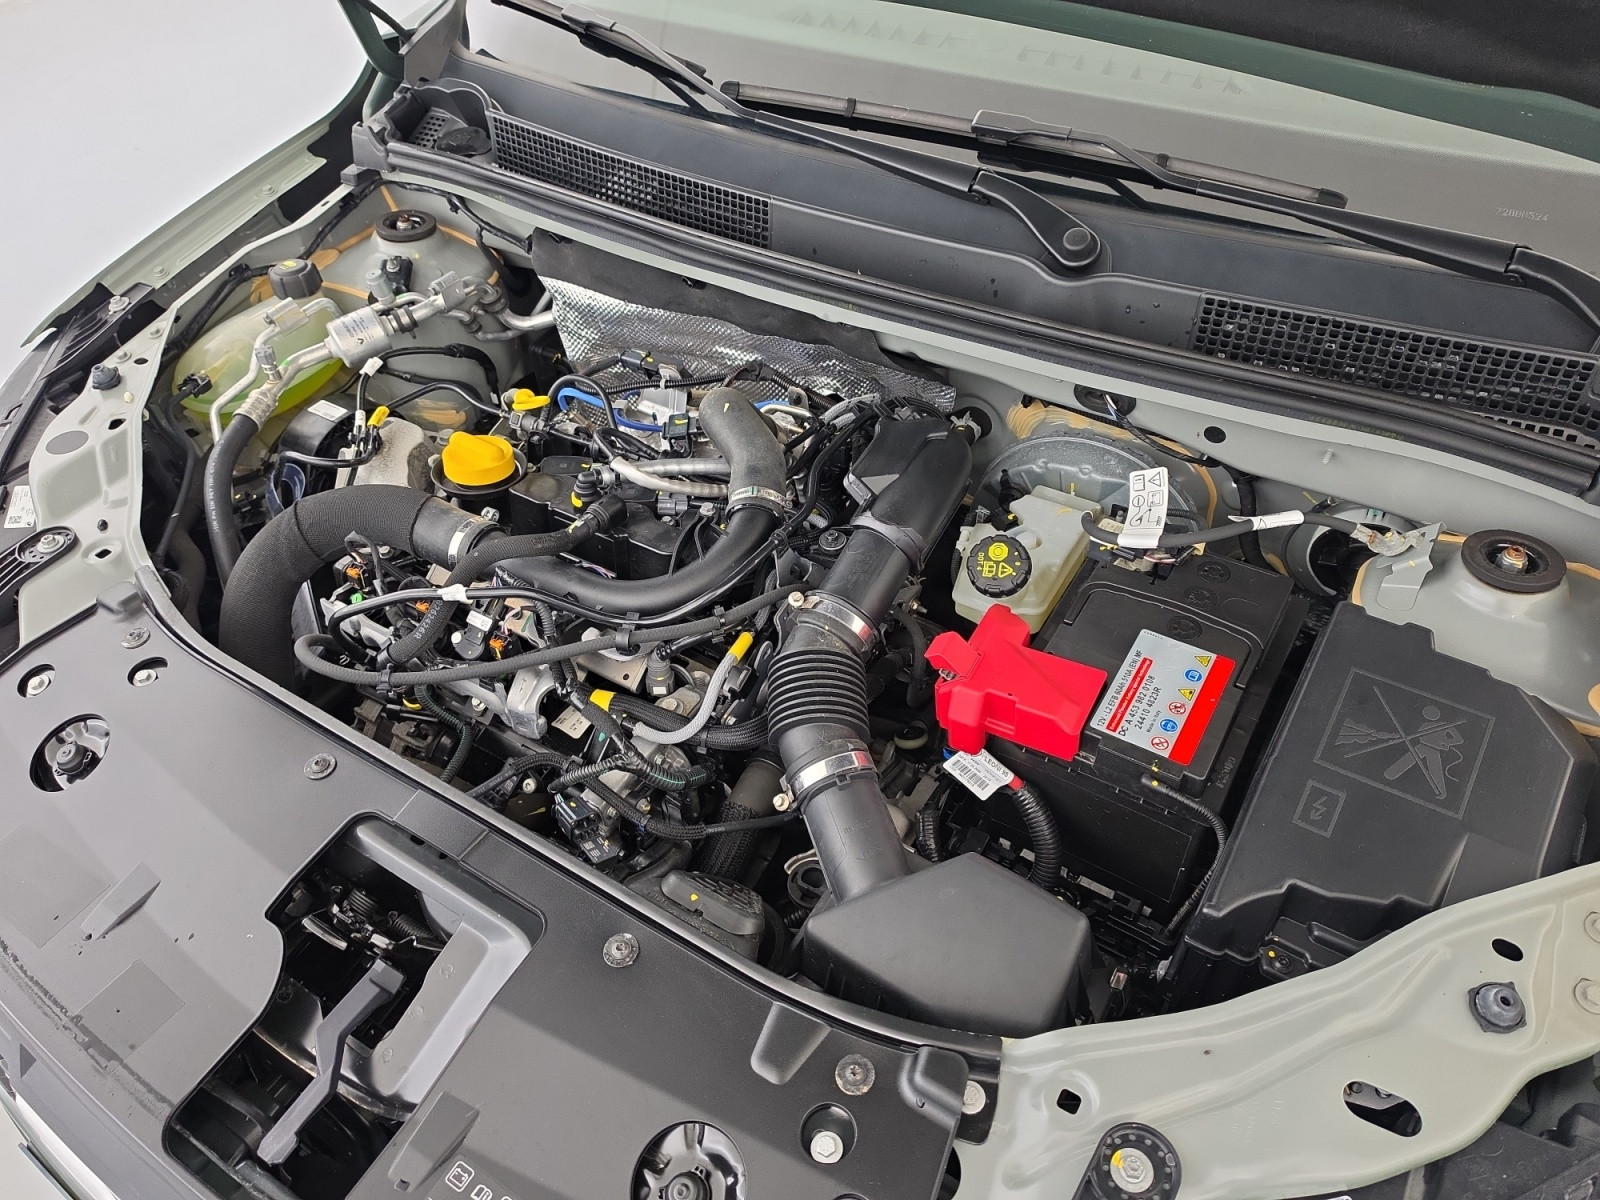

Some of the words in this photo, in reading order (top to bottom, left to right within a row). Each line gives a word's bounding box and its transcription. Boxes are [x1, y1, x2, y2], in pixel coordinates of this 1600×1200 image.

[1108, 695, 1119, 707] EFB
[1118, 725, 1129, 737] DC
[1129, 705, 1140, 718] 453
[1136, 691, 1147, 705] 982
[1142, 675, 1156, 692] 0108
[1104, 705, 1113, 715] L2
[1097, 715, 1106, 727] 12V
[1134, 708, 1150, 730] 24410
[1146, 721, 1155, 734] Made
[984, 756, 1002, 773] LEONI
[1002, 769, 1010, 778] 95
